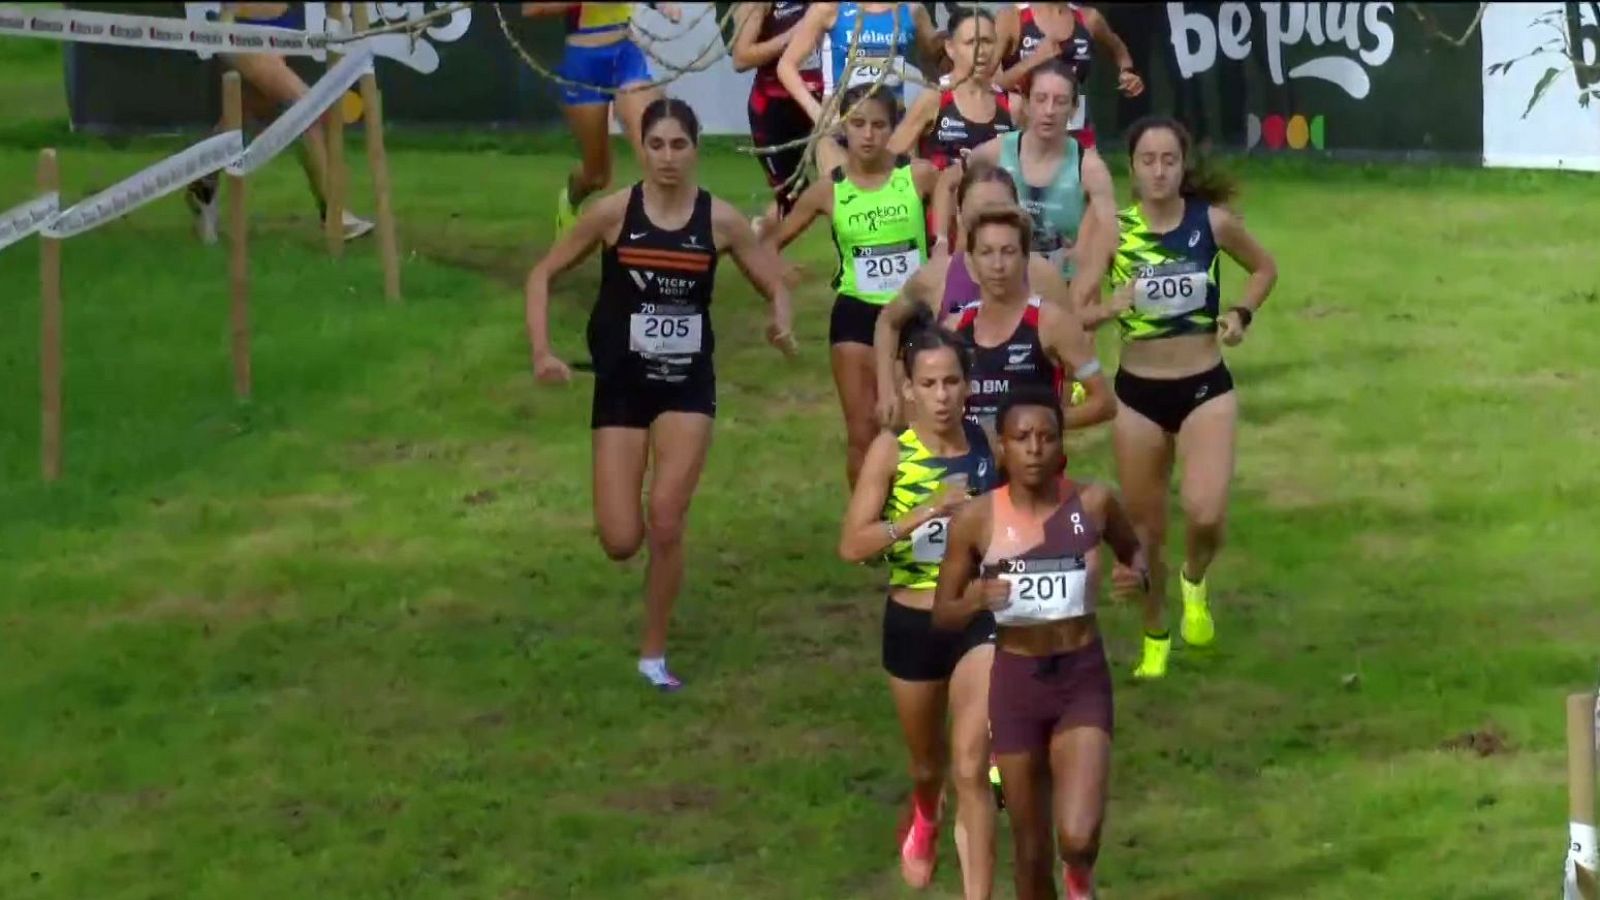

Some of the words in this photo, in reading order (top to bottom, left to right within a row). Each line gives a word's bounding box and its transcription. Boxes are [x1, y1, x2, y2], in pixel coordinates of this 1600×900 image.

[1261, 3, 1394, 85] plus
[849, 204, 909, 229] motion
[865, 255, 908, 279] 203
[656, 277, 696, 289] VICKY
[1145, 276, 1193, 301] 206
[644, 318, 690, 338] 205
[1008, 561, 1026, 573] 70
[1018, 575, 1067, 600] 201
